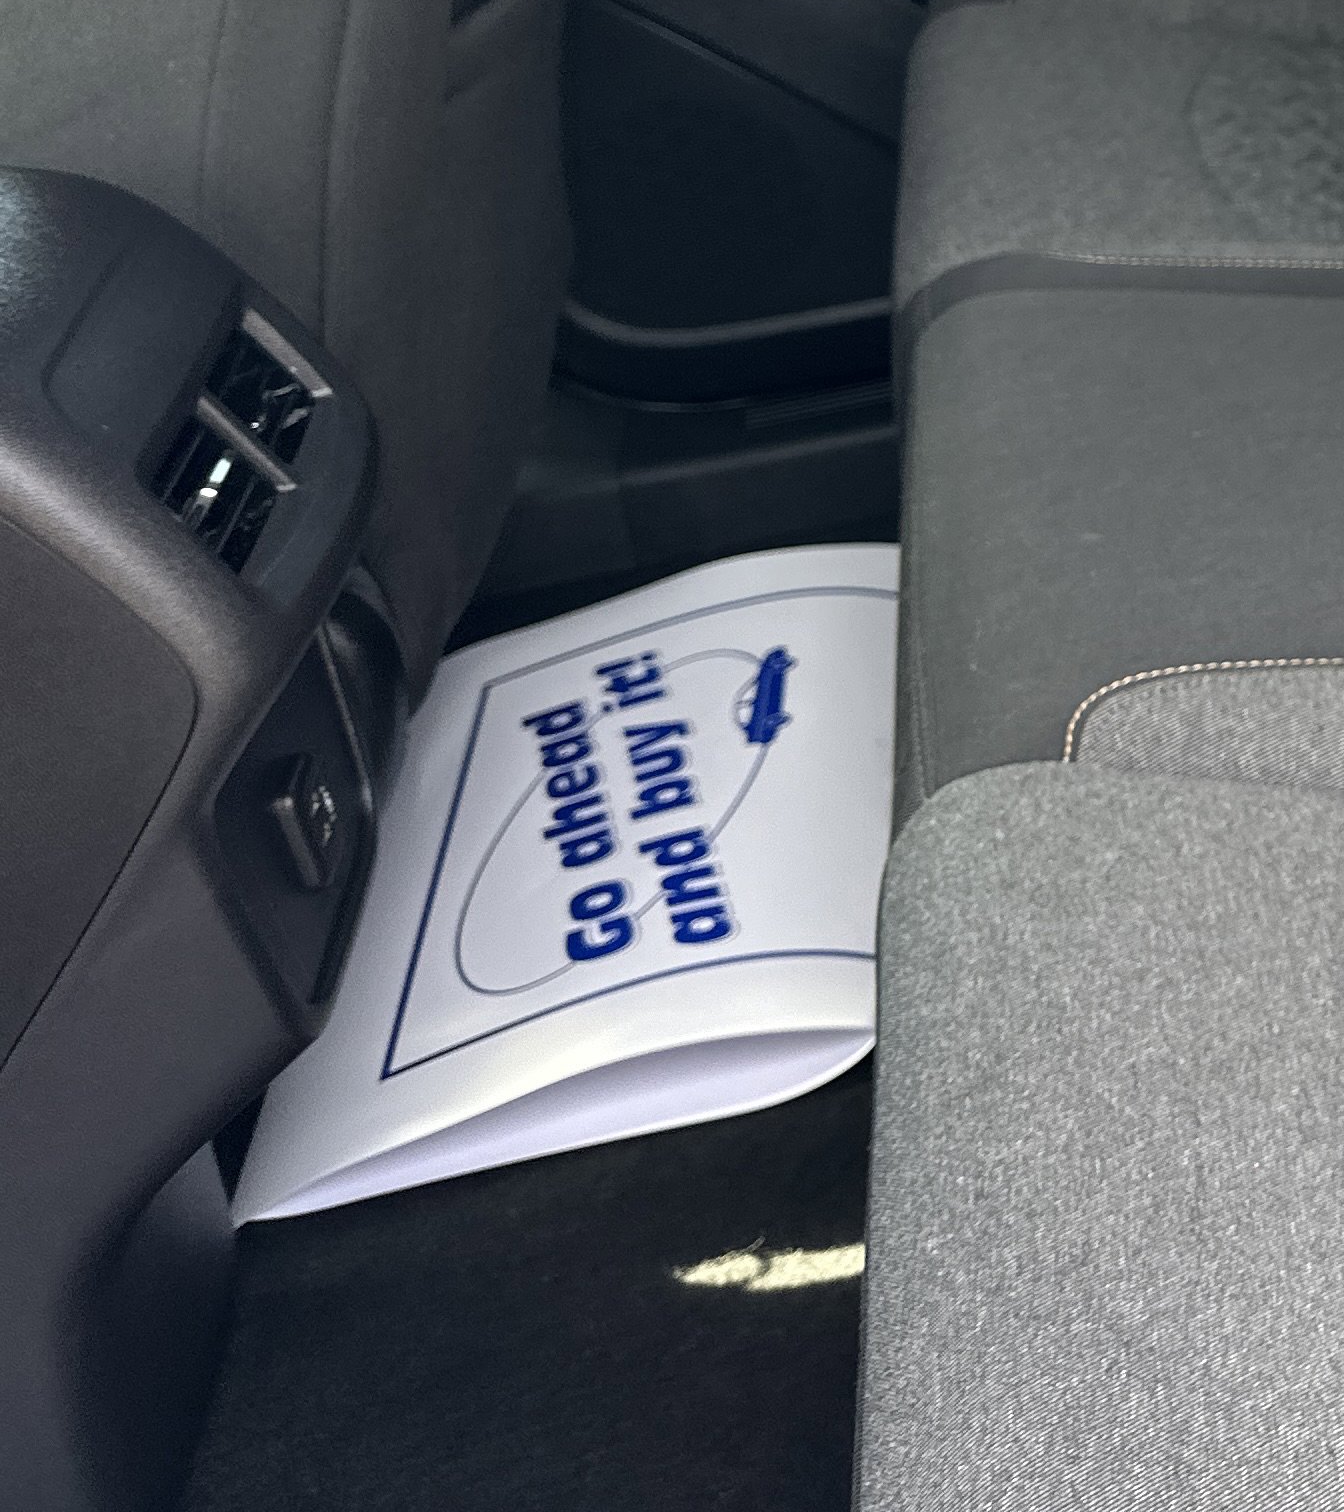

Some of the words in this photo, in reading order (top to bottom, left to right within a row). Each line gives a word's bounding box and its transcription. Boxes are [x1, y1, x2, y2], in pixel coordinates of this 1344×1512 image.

[596, 651, 664, 714] it!
[522, 703, 614, 868] ahead
[624, 722, 695, 819] buy
[565, 879, 634, 961] Go
[638, 829, 732, 944] and
